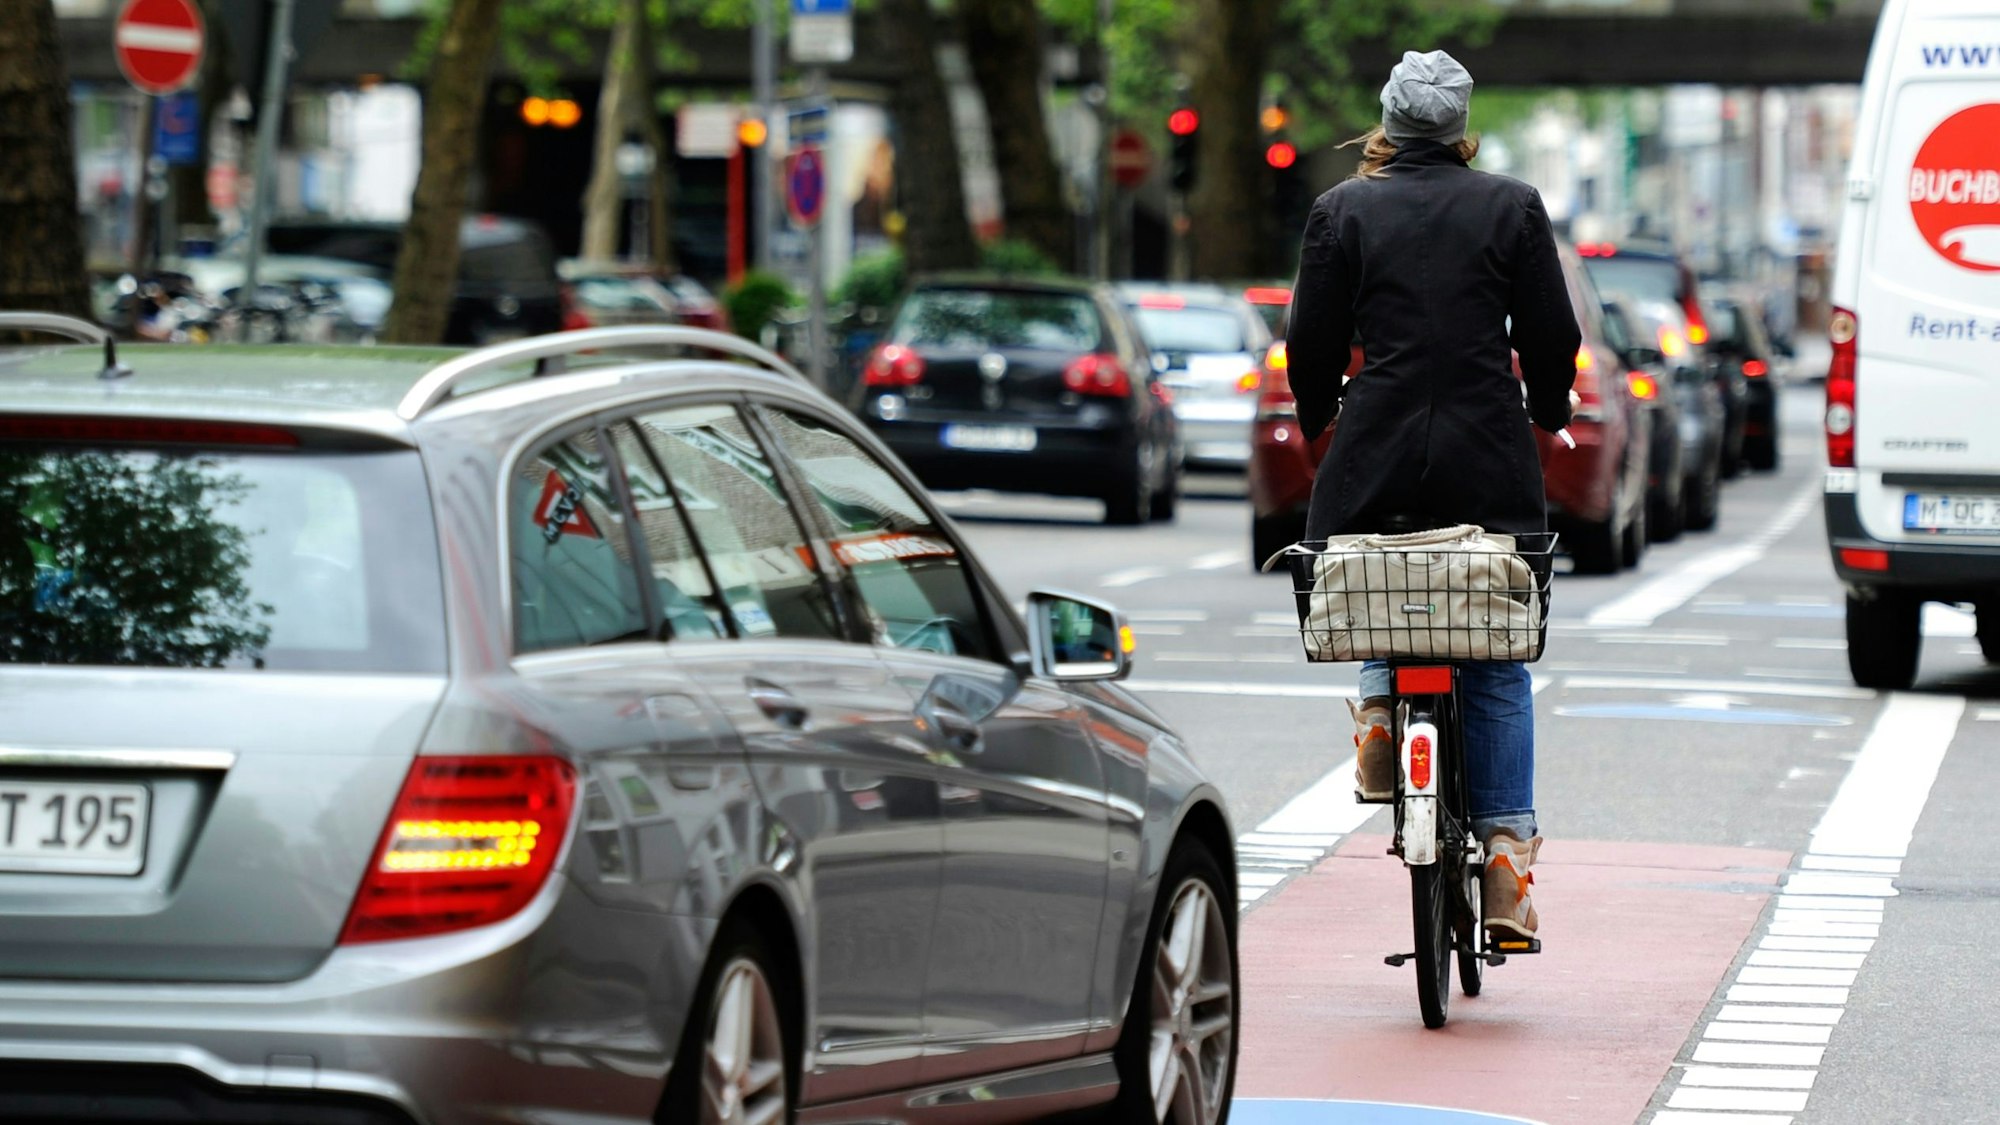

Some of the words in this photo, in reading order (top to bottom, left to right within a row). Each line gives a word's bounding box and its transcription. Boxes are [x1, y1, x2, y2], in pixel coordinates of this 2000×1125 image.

[1922, 46, 2000, 65] ww
[1910, 167, 2000, 204] BUCHB
[41, 794, 136, 849] 195
